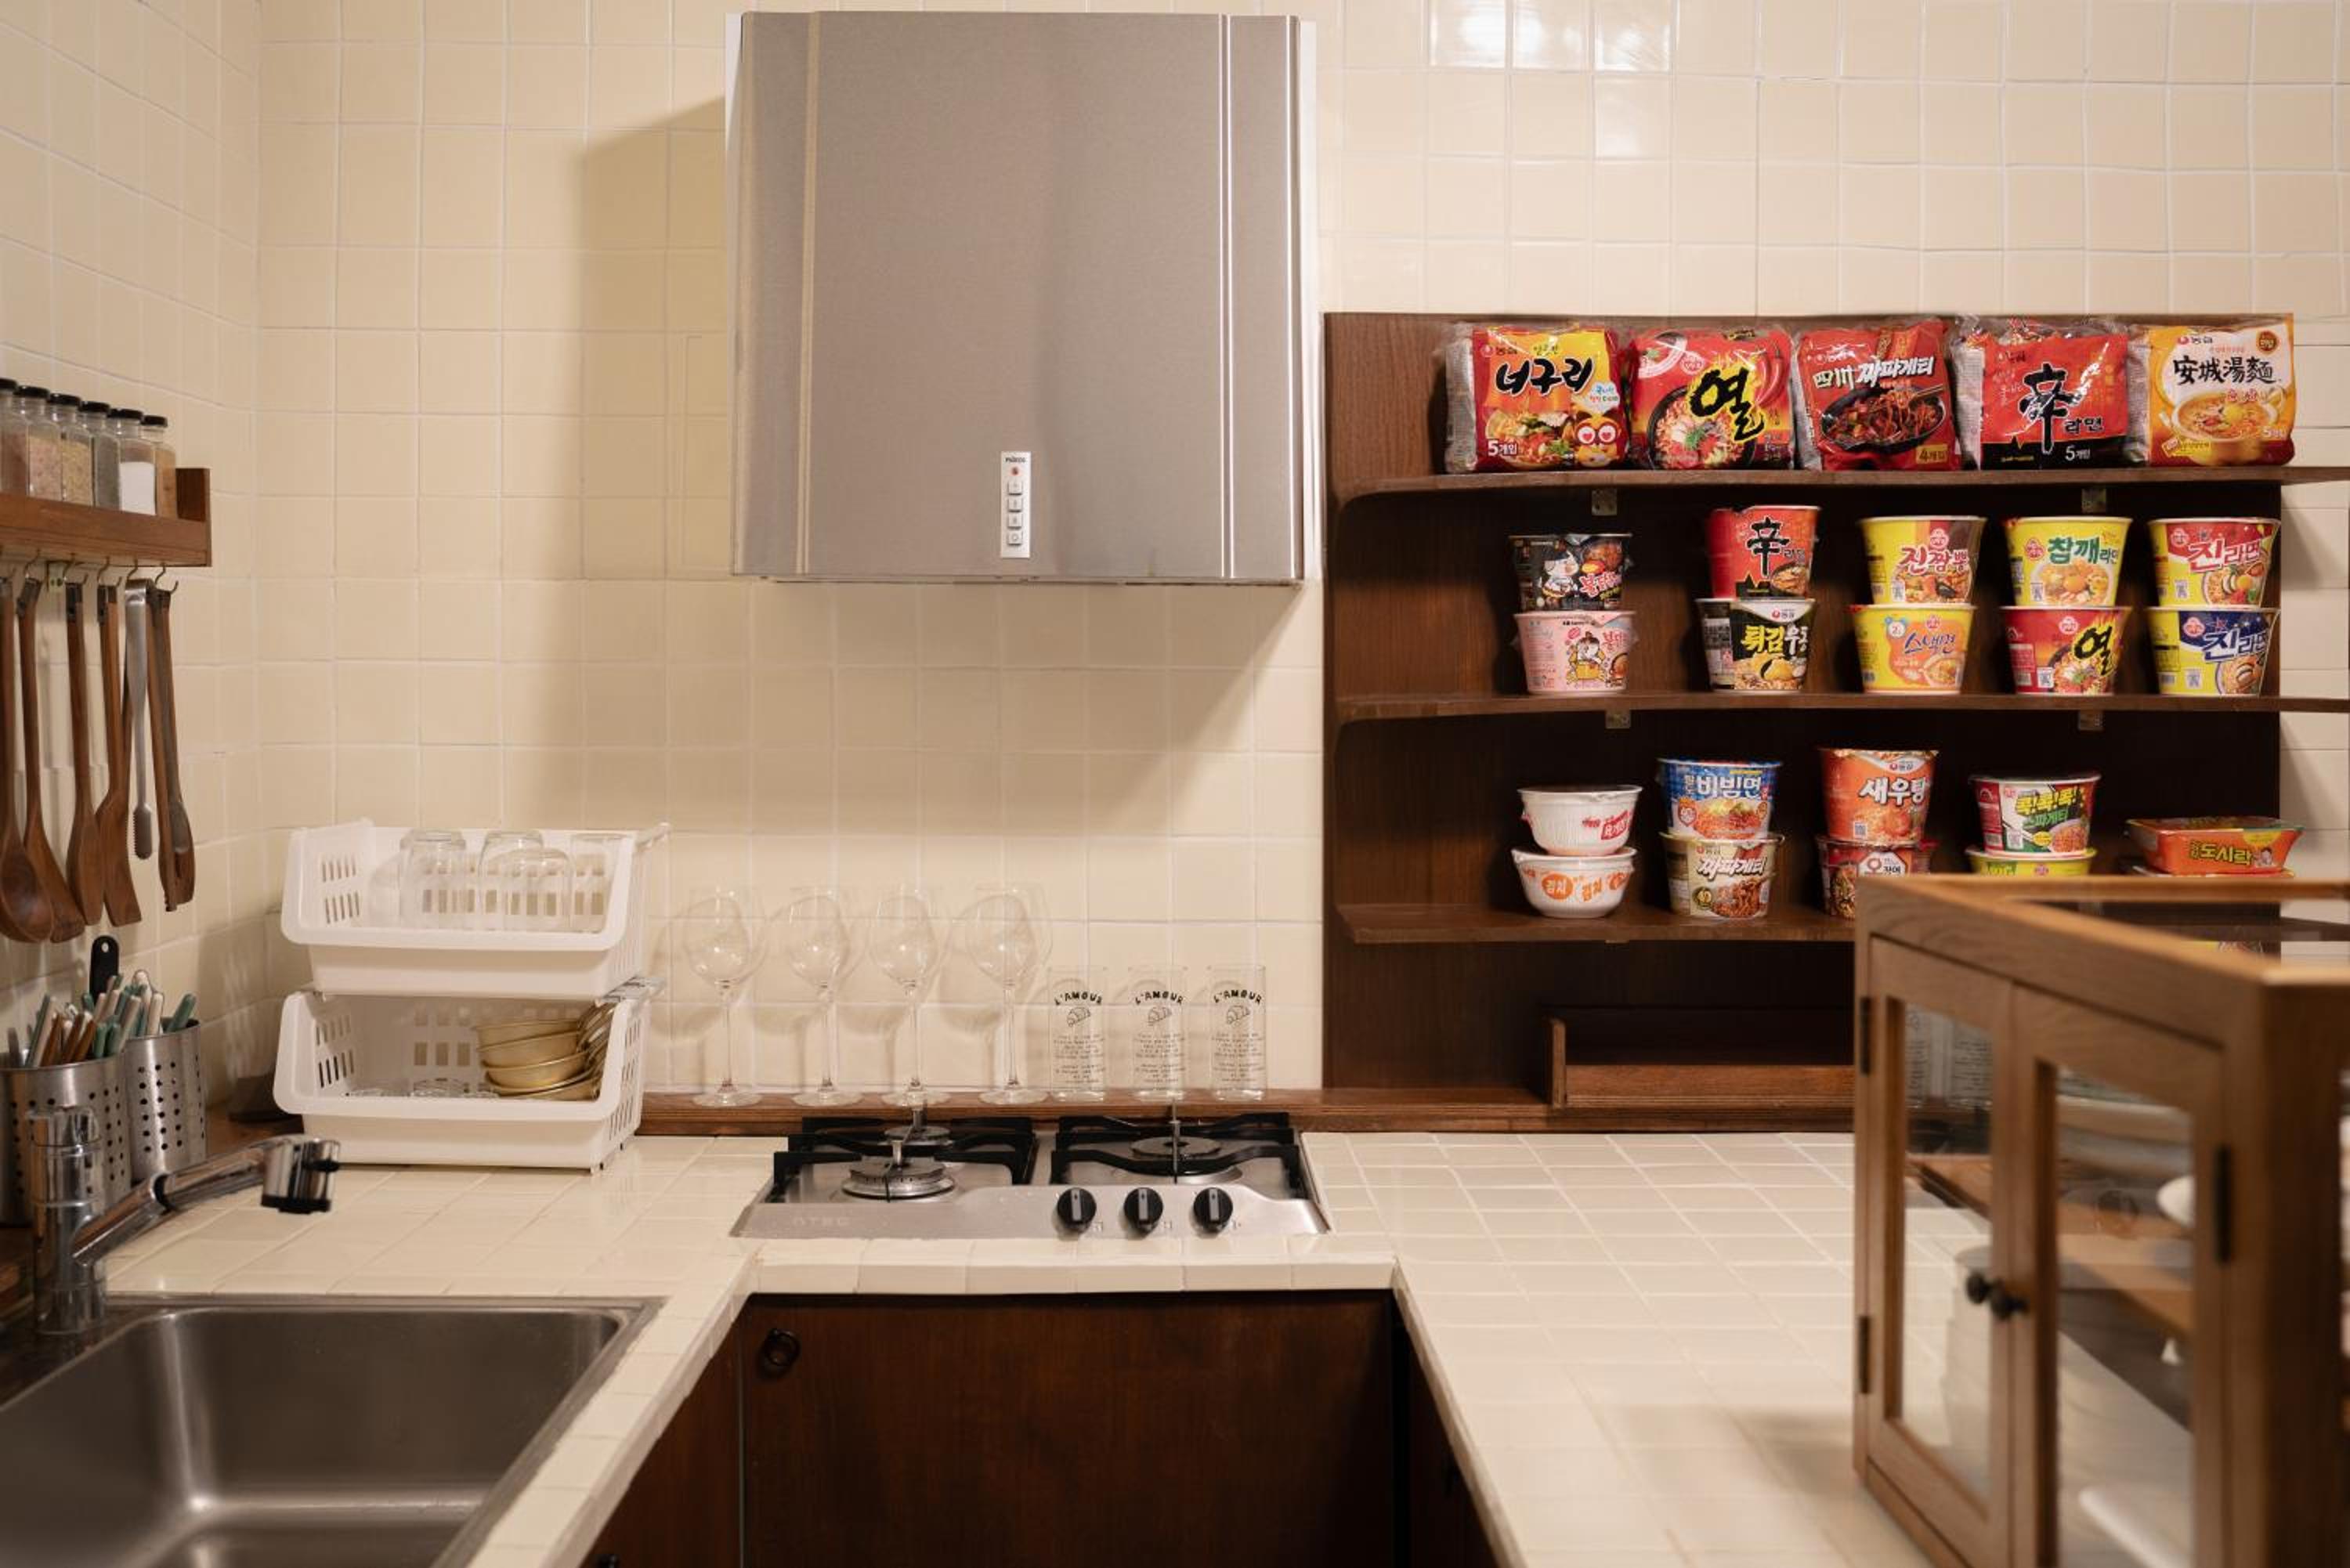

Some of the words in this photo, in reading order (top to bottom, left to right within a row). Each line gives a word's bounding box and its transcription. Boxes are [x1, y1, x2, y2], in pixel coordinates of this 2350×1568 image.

[1495, 356, 1594, 396] 너구리
[1856, 356, 1934, 387] 짜파게티
[2188, 538, 2261, 572] 진라면
[2200, 843, 2254, 865] 도시락
